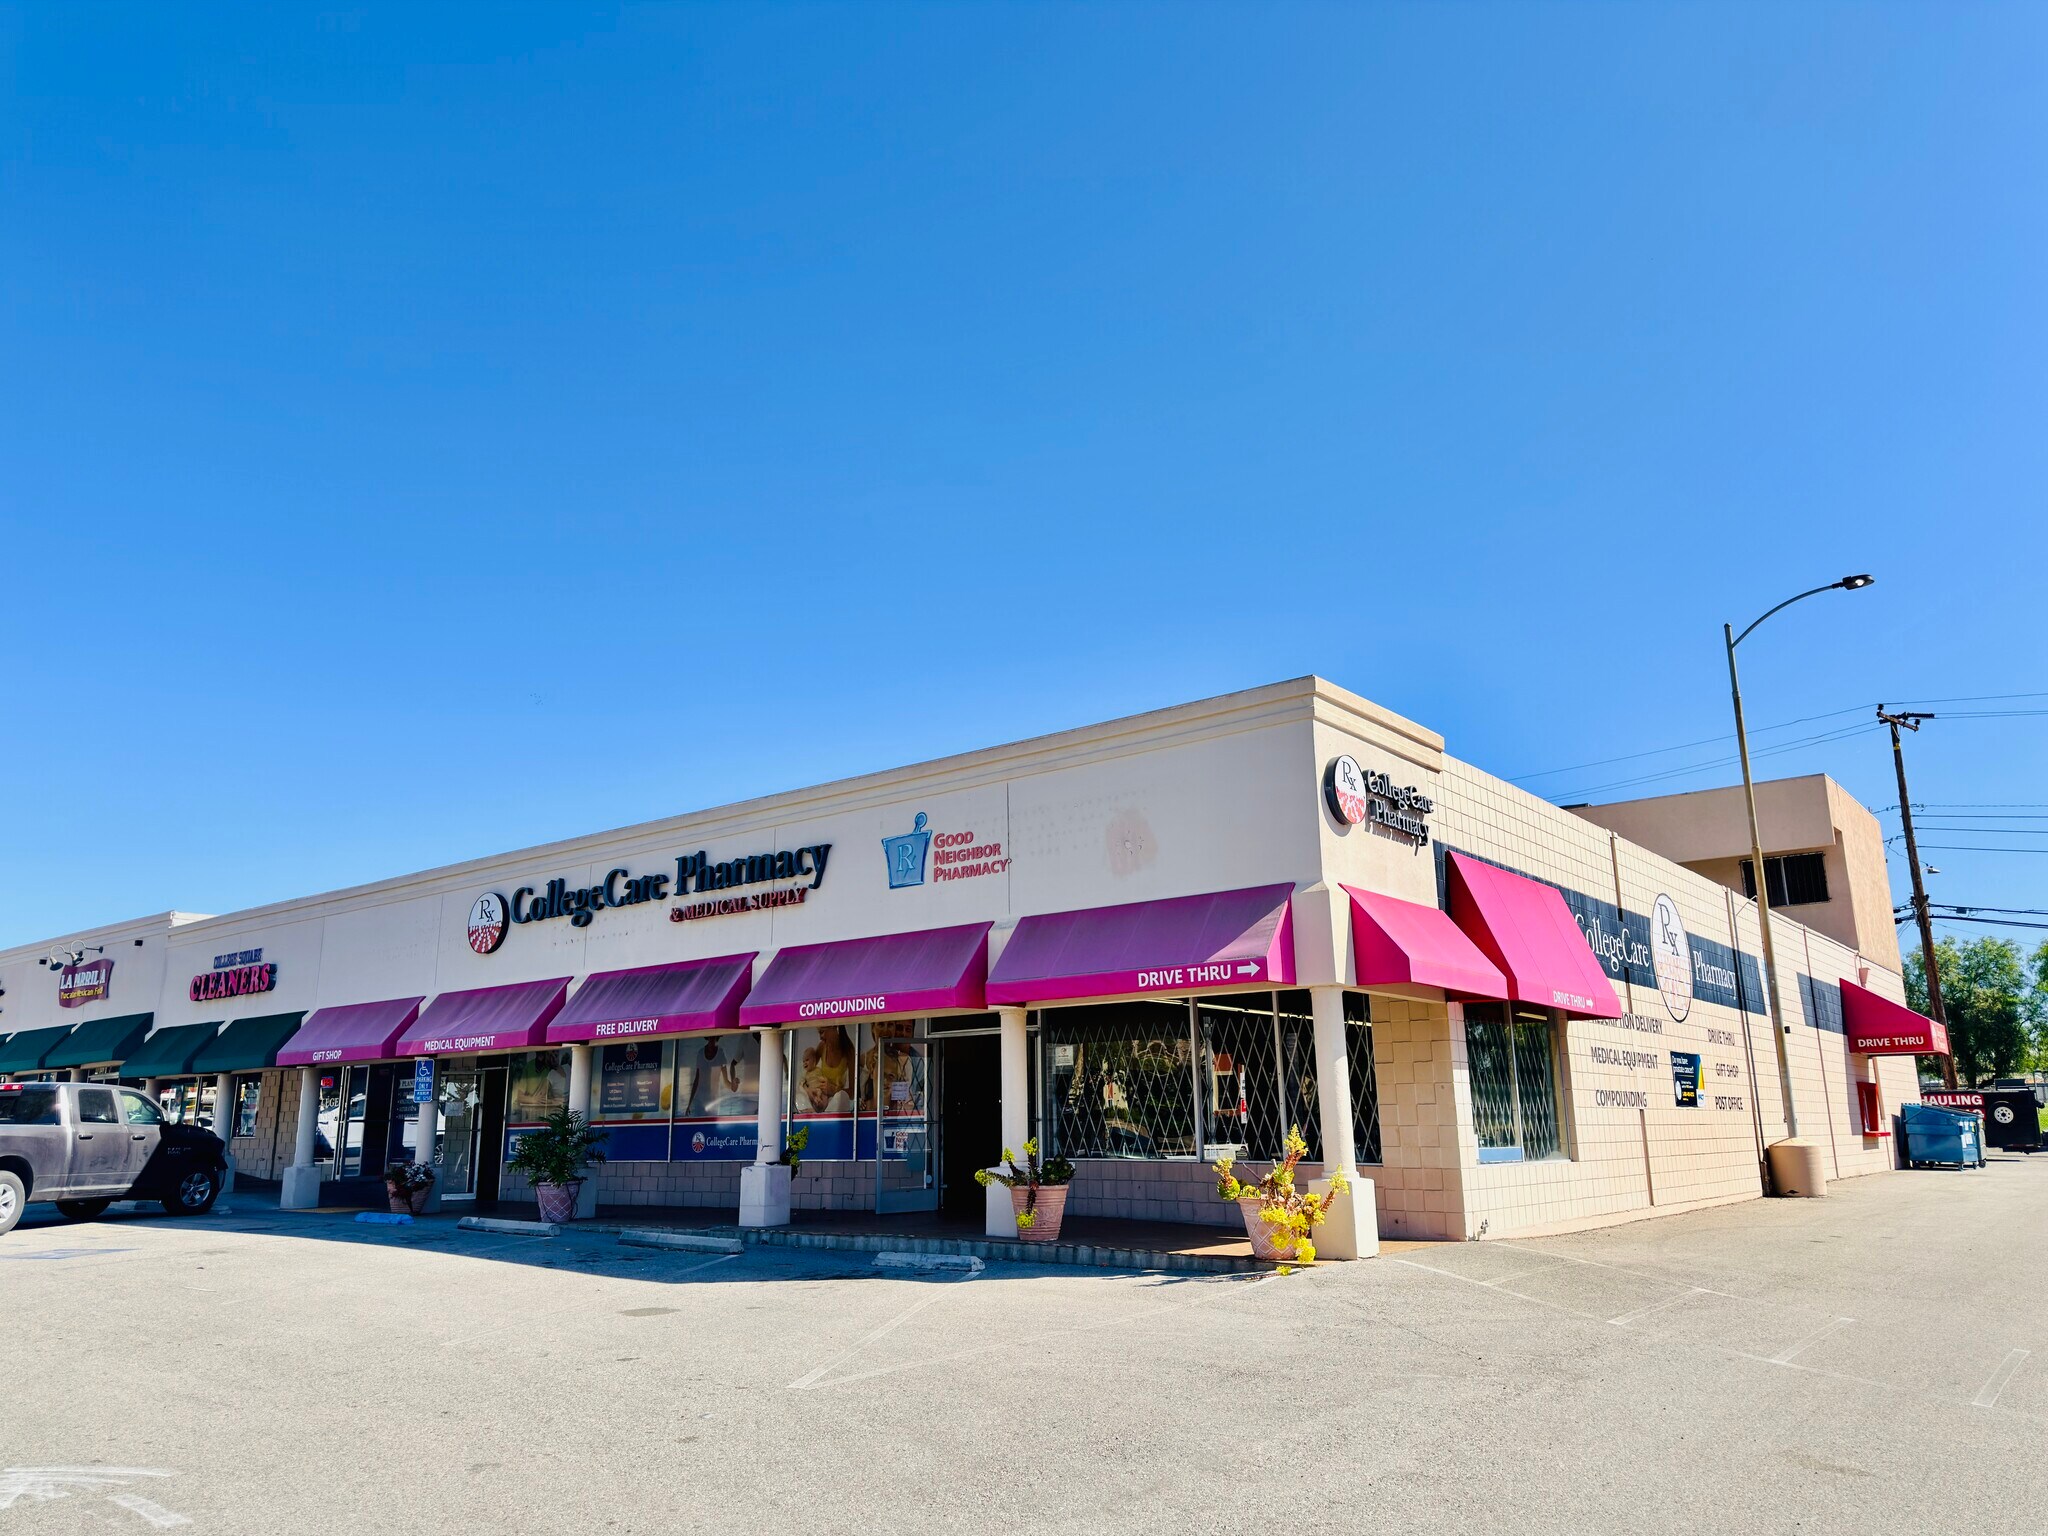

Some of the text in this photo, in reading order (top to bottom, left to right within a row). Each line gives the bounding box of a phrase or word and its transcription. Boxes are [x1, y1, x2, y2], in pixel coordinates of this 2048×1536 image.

[1370, 799, 1429, 846] Pharmacy
[933, 831, 974, 849] GOOD
[933, 843, 1002, 866] NEIGHBOR
[933, 859, 1009, 882] PHARMACY
[510, 844, 832, 927] CollegeCare Pharmacy
[683, 896, 748, 920] MEDICAL
[750, 887, 808, 910] SUPPLY
[60, 974, 73, 989] LA
[190, 963, 274, 1001] CLEANERS
[1138, 964, 1231, 987] DRIVE THRU
[1693, 950, 1737, 1000] Pharmacy
[799, 996, 885, 1016] COMPOUNDING
[1553, 990, 1585, 1008] DRIVE THRU
[596, 1019, 658, 1035] FREE DELIVERY
[1635, 1016, 1662, 1034] DELIVERY
[424, 1035, 495, 1051] MEDICAL EQUIPMENT
[1708, 1029, 1735, 1046] DRIVE THRU
[1857, 1036, 1924, 1047] DRIVE THRU
[313, 1050, 342, 1060] GIFT SHOP
[1591, 1046, 1658, 1070] MEDICAL EQUIPMENT
[1716, 1063, 1739, 1078] GIFT SHOP
[1595, 1090, 1647, 1107] COMPOUNDING
[1715, 1096, 1727, 1110] POST
[1728, 1097, 1743, 1110] OFFICE
[1921, 1095, 1982, 1106] HAULING
[706, 1136, 758, 1149] CollegeCare Pharm
